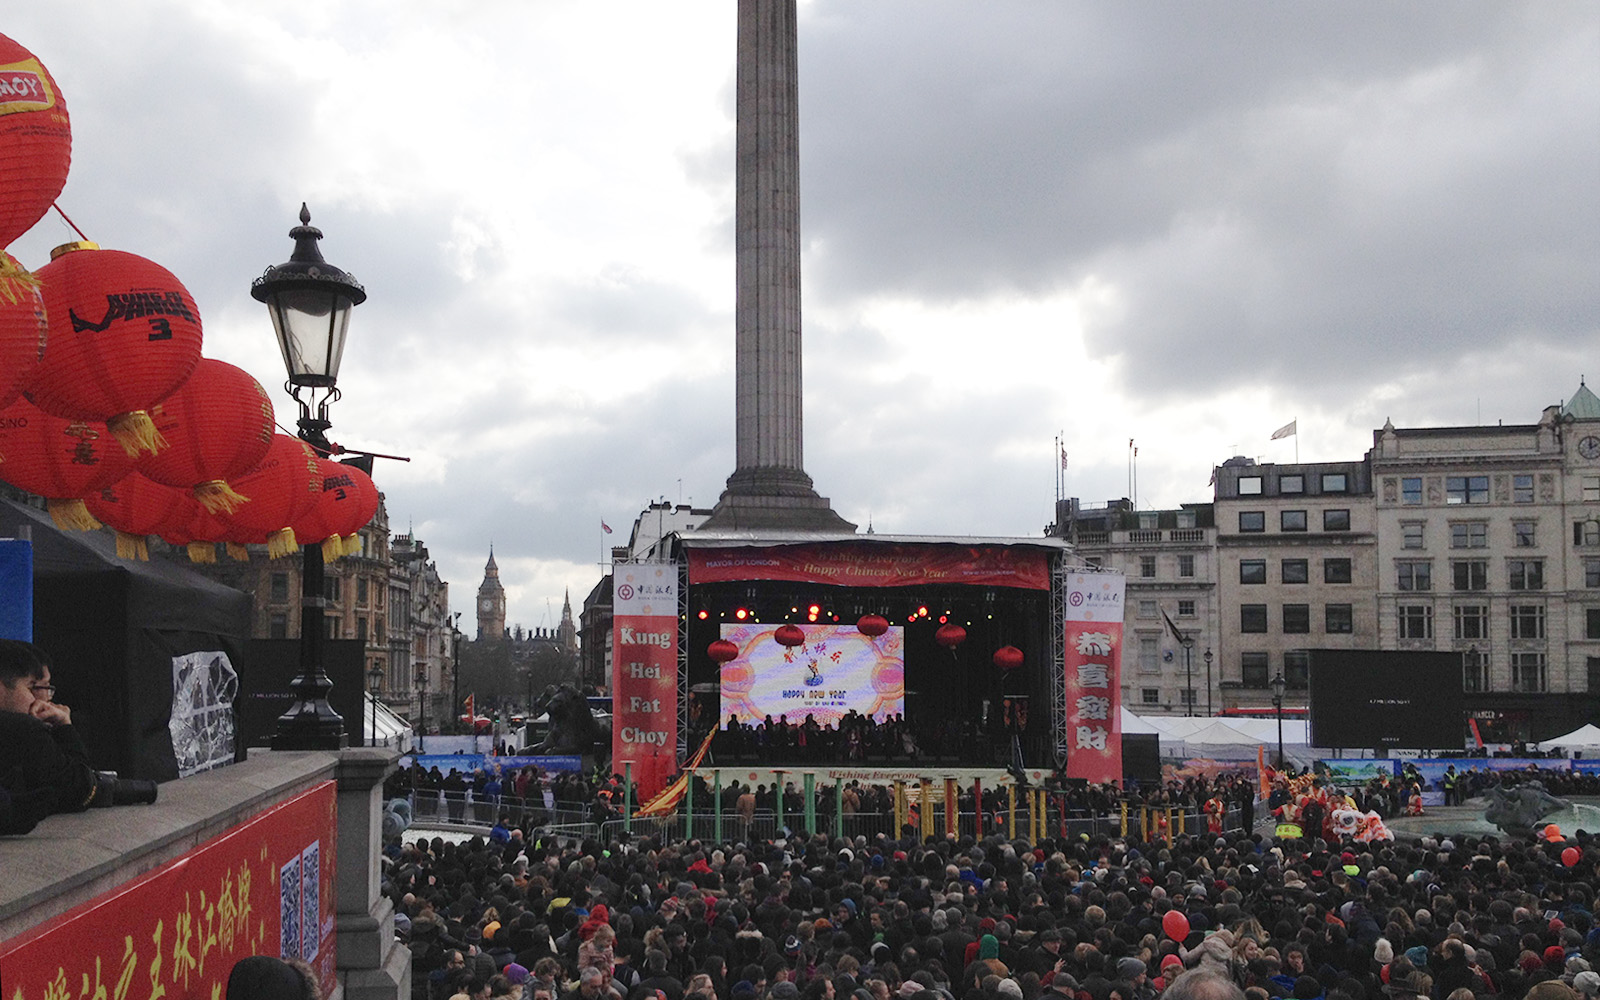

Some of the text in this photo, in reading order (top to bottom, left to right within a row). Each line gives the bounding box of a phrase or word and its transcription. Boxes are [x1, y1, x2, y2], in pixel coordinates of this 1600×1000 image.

[148, 318, 172, 341] 3
[705, 559, 780, 568] MAYOR OF LONDON
[803, 563, 843, 577] Happy
[845, 565, 891, 577] Chinese
[893, 567, 919, 577] New
[922, 567, 948, 578] Year
[620, 628, 671, 649] Kung
[630, 662, 661, 679] Hei
[1075, 631, 1112, 751] 恭喜發財
[630, 696, 661, 713] Fat
[620, 727, 669, 747] Choy
[828, 770, 871, 780] Wishing
